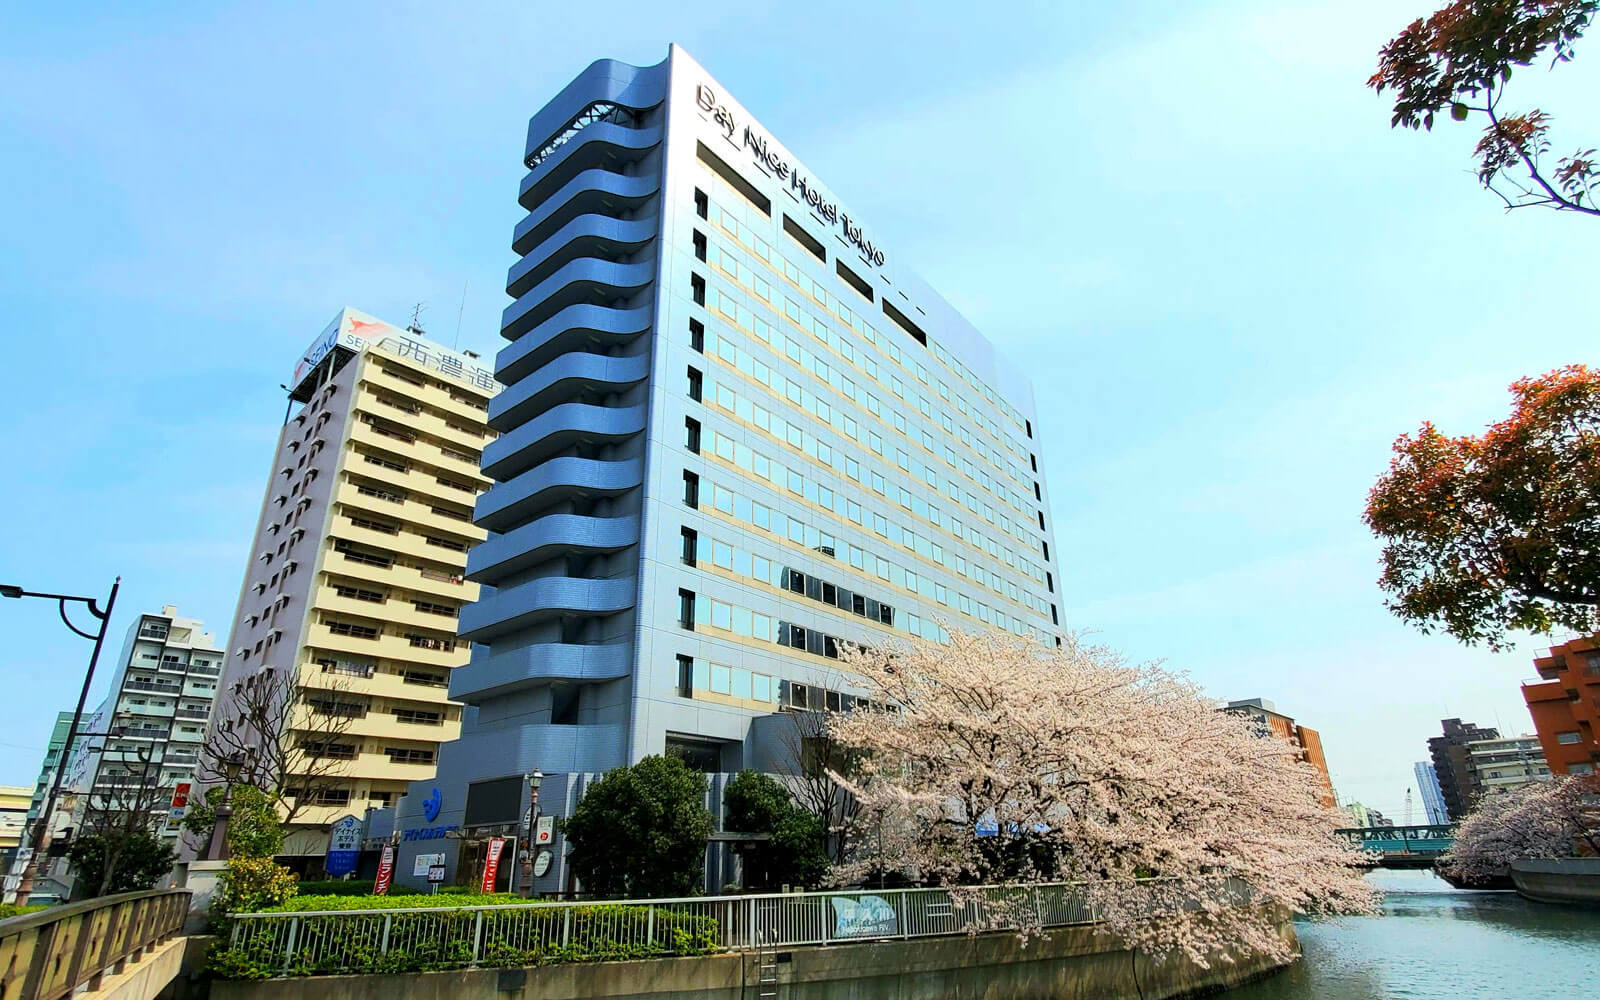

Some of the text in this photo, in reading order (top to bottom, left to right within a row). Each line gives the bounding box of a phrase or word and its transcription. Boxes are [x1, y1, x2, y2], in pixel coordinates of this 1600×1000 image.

[696, 83, 885, 267] Day Nice Hotel Tokyo
